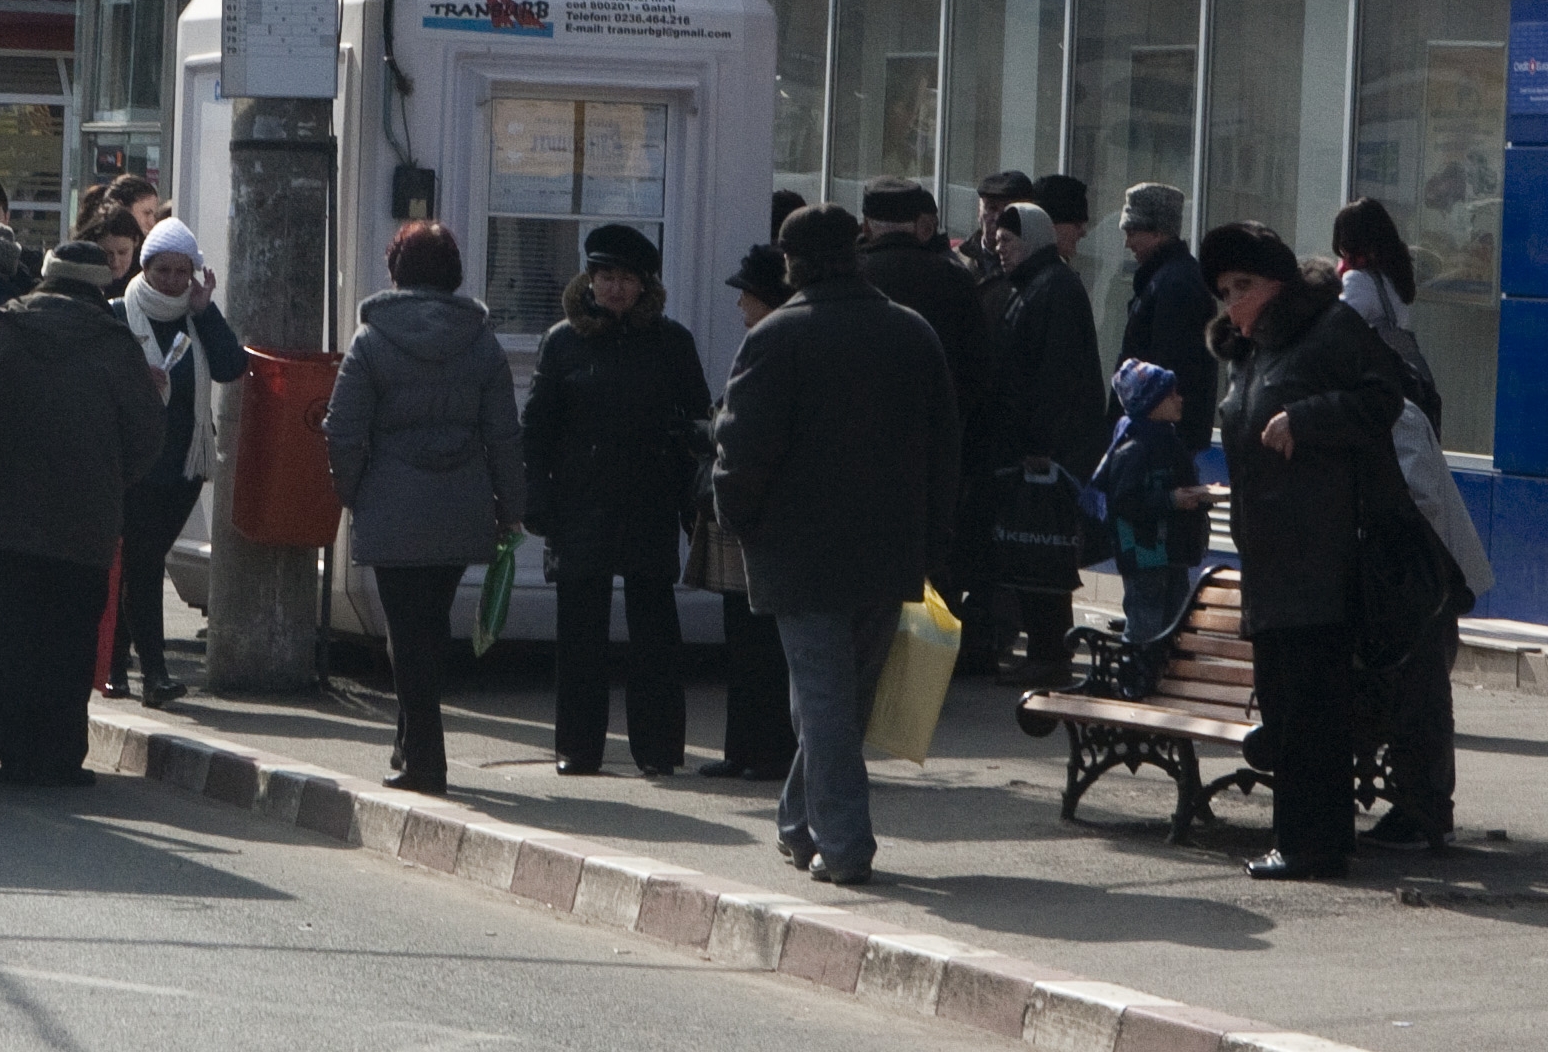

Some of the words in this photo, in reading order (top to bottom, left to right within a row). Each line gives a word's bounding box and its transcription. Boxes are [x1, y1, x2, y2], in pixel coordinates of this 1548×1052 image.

[566, 0, 587, 9] cod
[566, 11, 611, 22] Telefon:
[565, 22, 603, 34] E-mail:
